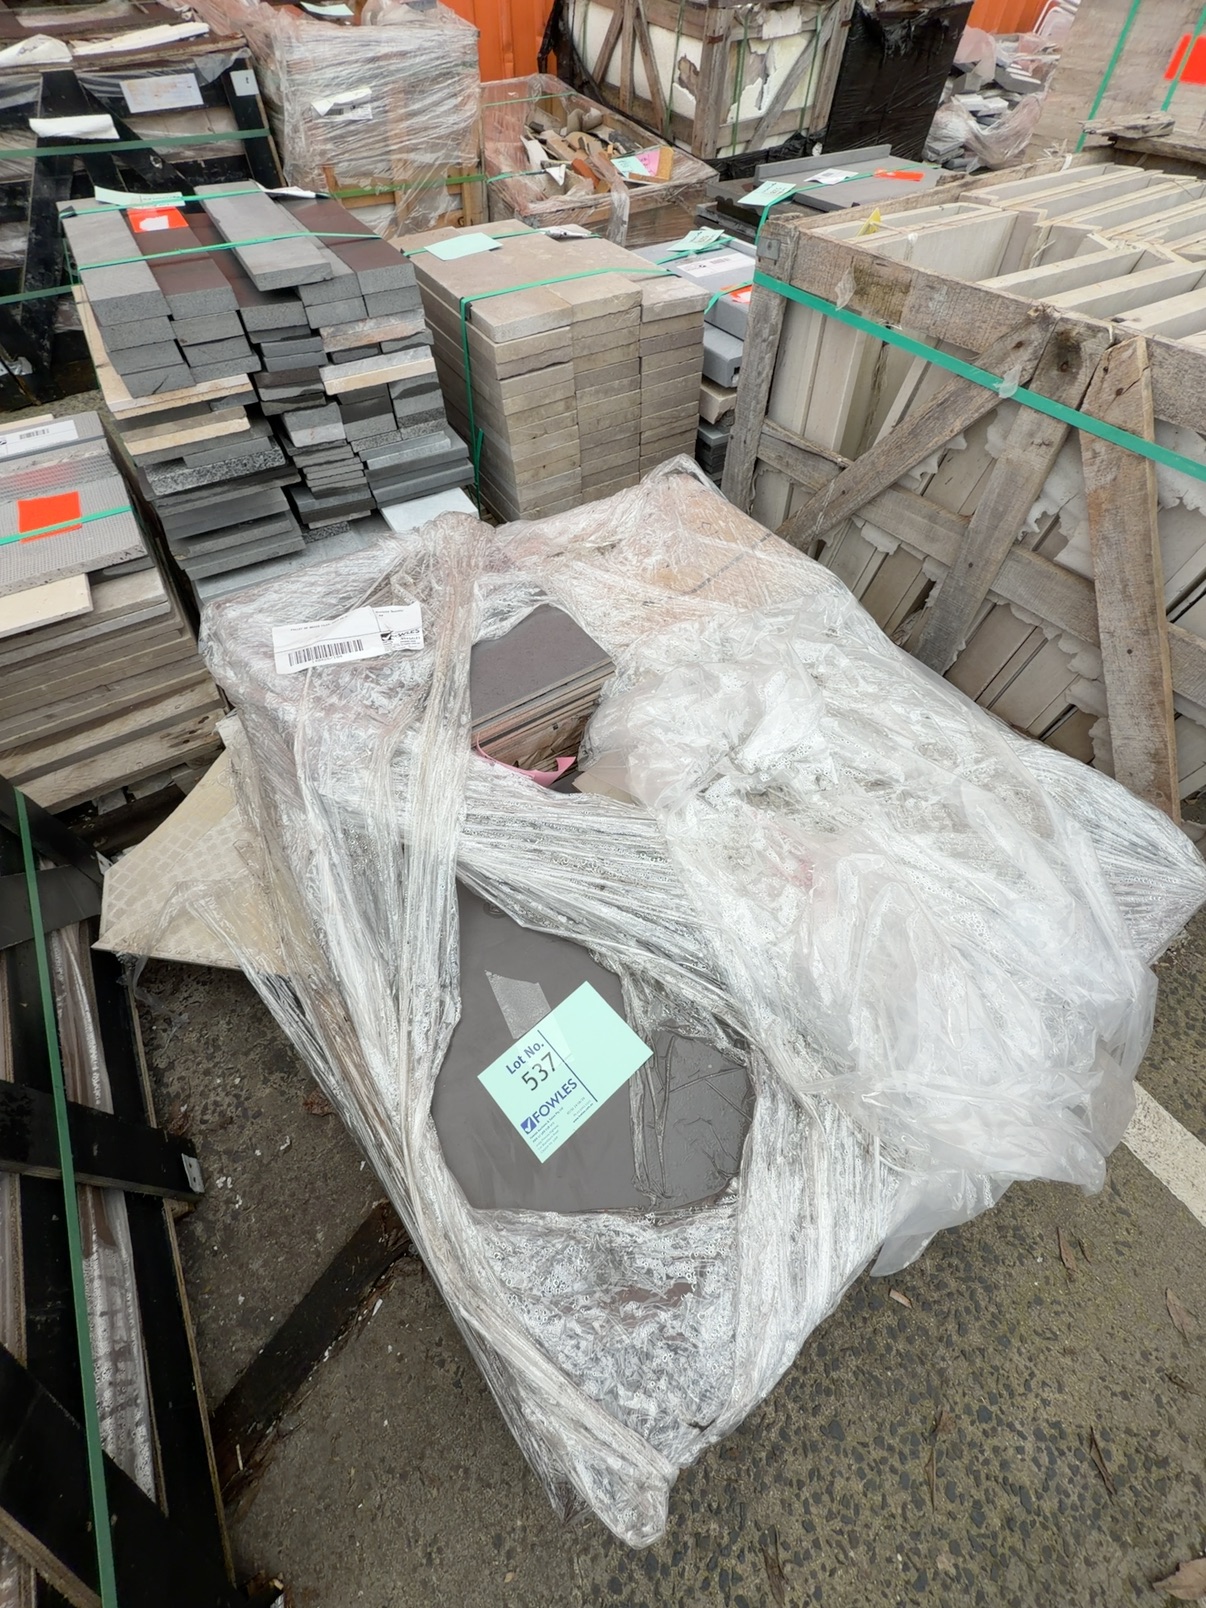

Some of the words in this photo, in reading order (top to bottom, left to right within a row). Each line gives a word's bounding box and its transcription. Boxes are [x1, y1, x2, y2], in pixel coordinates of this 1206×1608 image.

[505, 1055, 526, 1075] Lot
[523, 1042, 545, 1059] No.
[521, 1051, 556, 1091] 537
[532, 1078, 578, 1124] FOWLES
